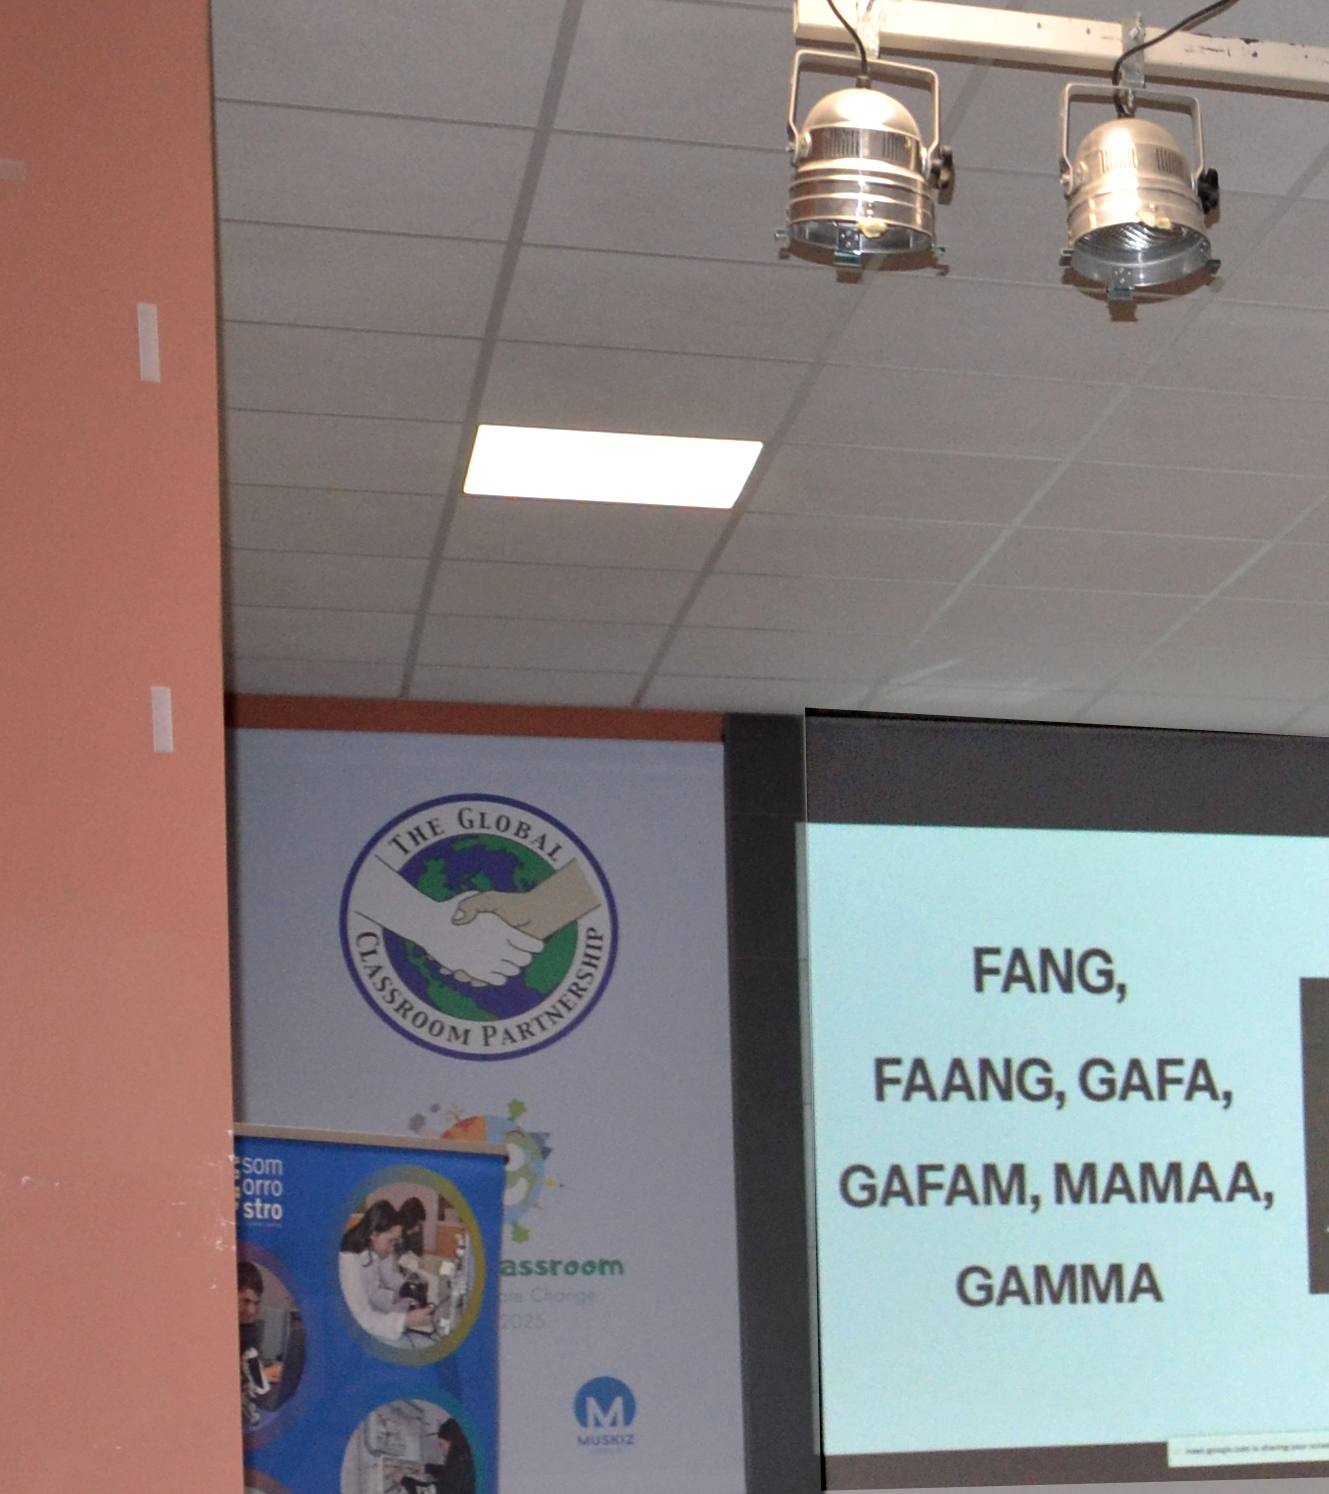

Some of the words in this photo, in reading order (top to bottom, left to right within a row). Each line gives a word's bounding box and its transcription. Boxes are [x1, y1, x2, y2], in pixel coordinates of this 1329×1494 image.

[388, 817, 446, 856] THE
[457, 806, 563, 861] GLOBAL
[355, 931, 470, 1046] CLASSROOM
[482, 926, 605, 1046] PARTNERSHIP
[973, 946, 1127, 1003] FANG,
[873, 1057, 1066, 1109] FAANG,
[1078, 1056, 1233, 1109] GAFA,
[242, 1157, 284, 1175] som
[242, 1178, 284, 1197] orro
[839, 1162, 1041, 1213] GAFAM,
[1053, 1161, 1275, 1210] MAMAA,
[243, 1198, 284, 1220] stro
[500, 1258, 624, 1277] assroom
[956, 1262, 1164, 1307] GAMMA
[577, 1434, 635, 1446] MUSKIZ
